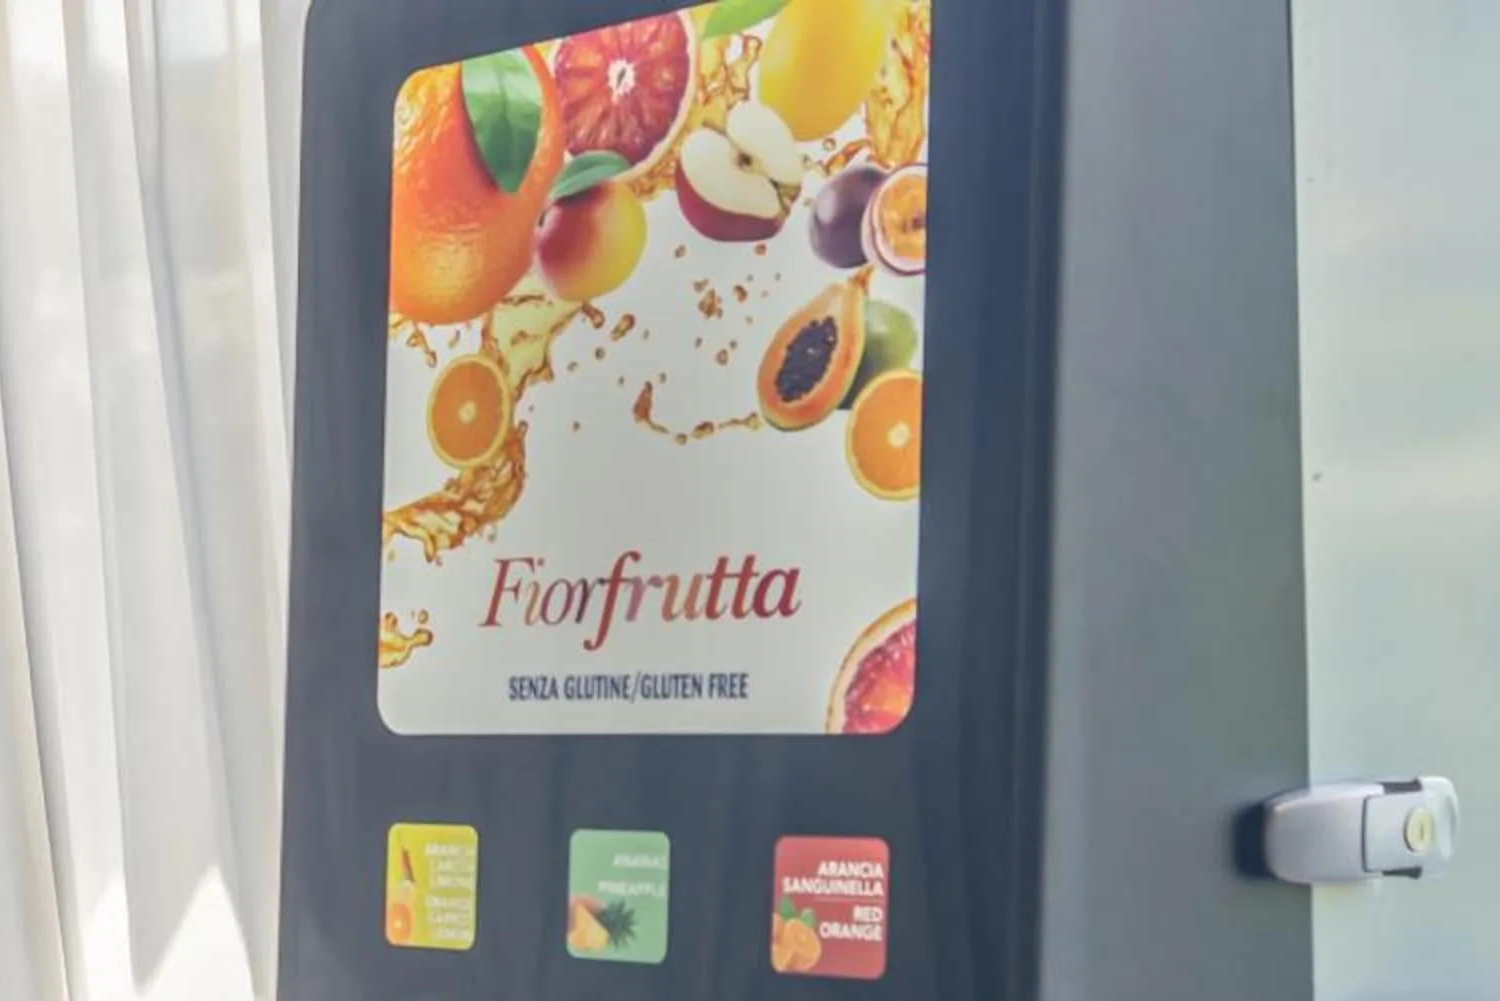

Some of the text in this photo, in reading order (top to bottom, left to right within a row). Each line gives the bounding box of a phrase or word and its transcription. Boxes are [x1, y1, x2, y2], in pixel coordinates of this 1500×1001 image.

[478, 550, 802, 651] Fiorfrutta
[508, 675, 559, 701] SENZA
[708, 672, 750, 699] FREE
[817, 860, 884, 878] ARANCIA
[782, 876, 884, 896] SANGUINELLA
[853, 905, 883, 922] RED
[819, 921, 884, 941] ORANGE
